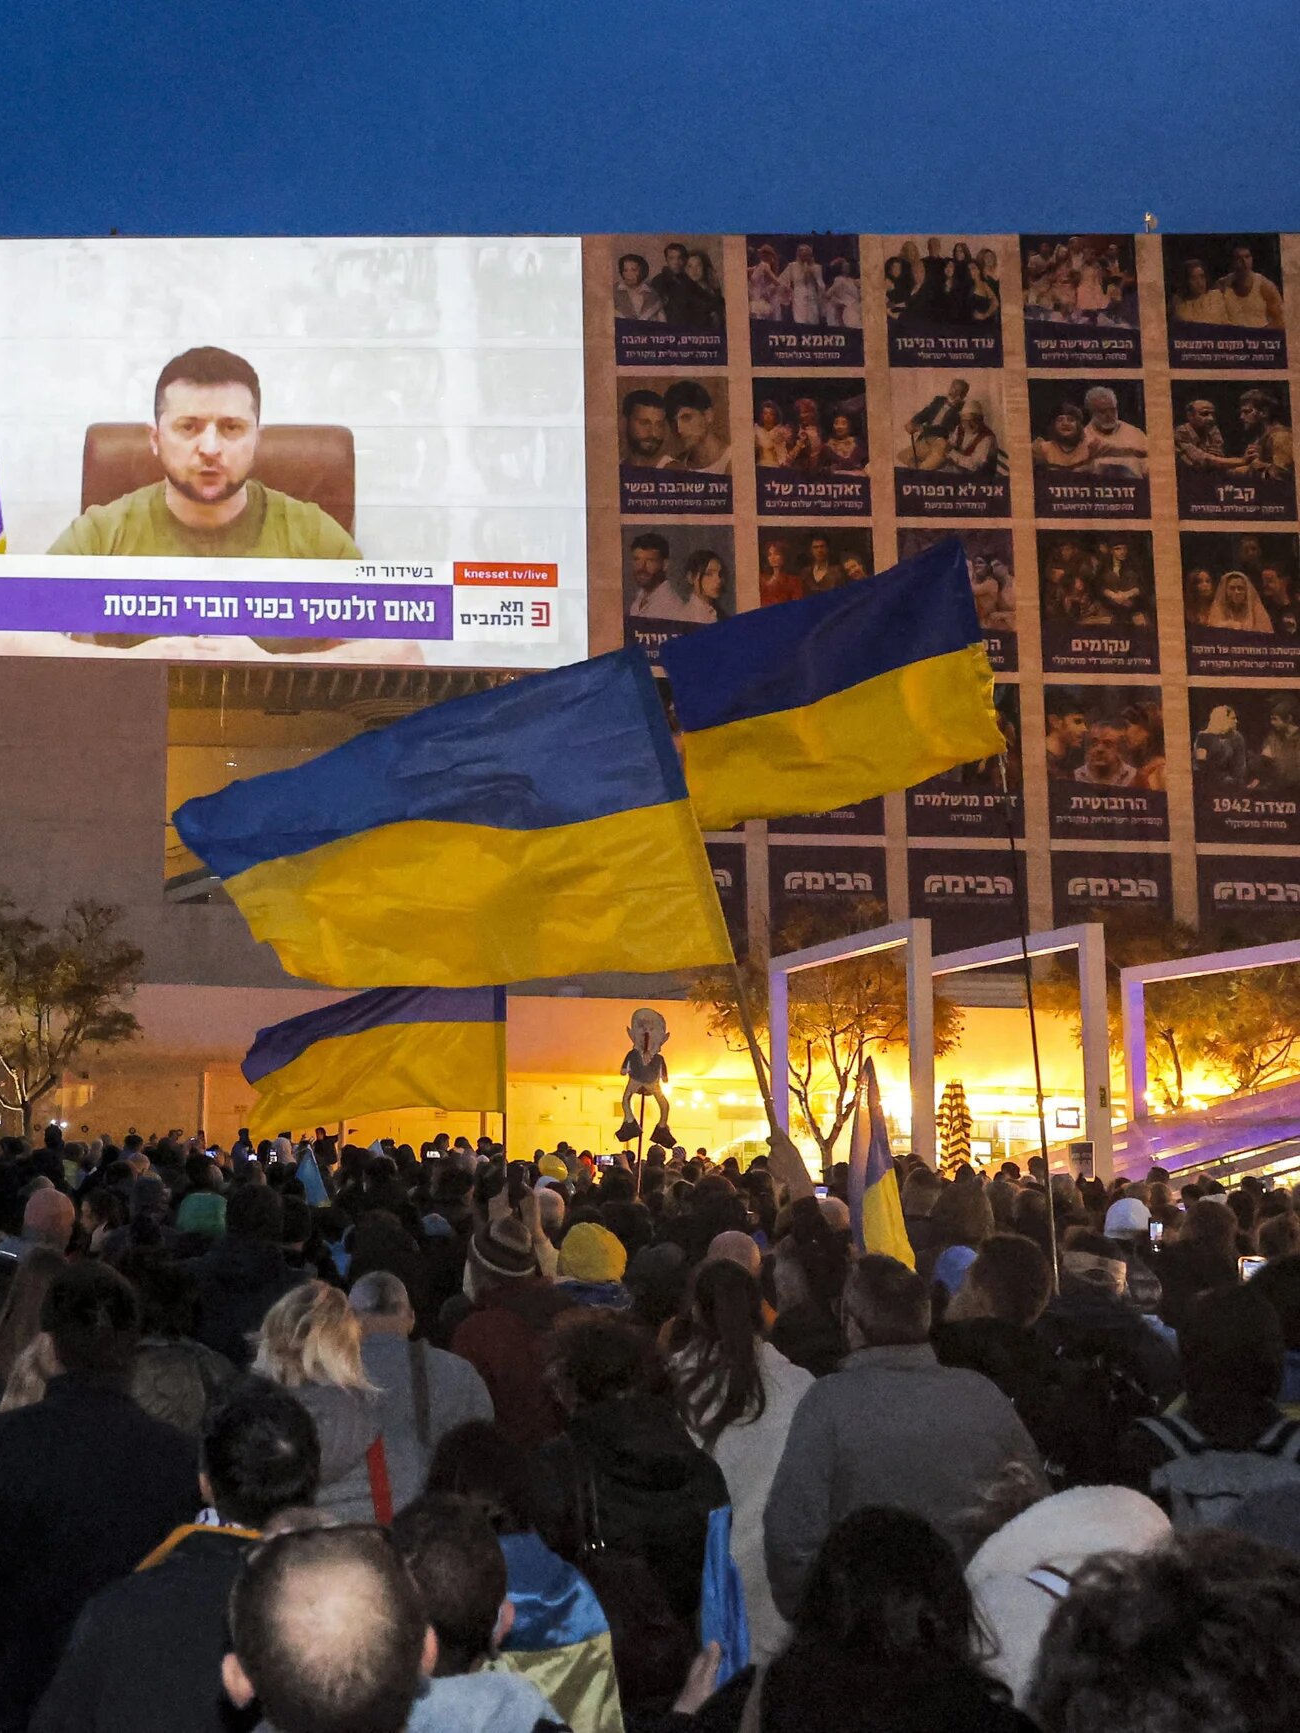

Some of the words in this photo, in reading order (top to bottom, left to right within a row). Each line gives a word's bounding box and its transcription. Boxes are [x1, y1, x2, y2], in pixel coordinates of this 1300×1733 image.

[622, 335, 647, 344] אהבה
[650, 335, 676, 344] סיפור
[768, 335, 797, 346] מיה
[801, 335, 845, 346] מאמא
[896, 338, 935, 350] הניגון
[938, 338, 968, 348] חוזר
[971, 338, 995, 348] עוד
[1033, 339, 1057, 349] עשר
[1059, 339, 1099, 349] השישה
[1102, 339, 1133, 349] הכבש
[1217, 340, 1244, 350] מקום
[1245, 339, 1259, 349] על
[1261, 340, 1281, 349] דבר
[658, 350, 694, 358] ישראלית
[695, 350, 718, 358] דרמה
[623, 482, 655, 493] נפשי
[659, 482, 705, 493] שאהבה
[708, 483, 728, 493] את
[764, 481, 793, 495] שלי
[798, 483, 862, 498] זאקופנה
[902, 485, 954, 496] רפפורט
[958, 482, 977, 496] לא
[980, 485, 1004, 496] אני
[1048, 487, 1091, 498] היווני
[1094, 487, 1136, 498] זורבה
[791, 499, 812, 508] שלום
[356, 566, 376, 577] חי:
[380, 566, 433, 578] בשידור
[464, 568, 548, 580] knesset.tv/live
[104, 595, 178, 616] הכנסת
[184, 596, 239, 618] חברי
[245, 597, 294, 620] בפני
[300, 595, 377, 625] זלנסקי
[383, 600, 435, 622] נאום
[500, 601, 523, 612] תא
[460, 613, 523, 626] הכתבים
[1071, 639, 1130, 654] עקומים
[914, 792, 980, 806] מושלמים
[1070, 797, 1147, 810] הרובוטית
[1213, 798, 1251, 812] 1942
[1254, 801, 1296, 814] מצדה
